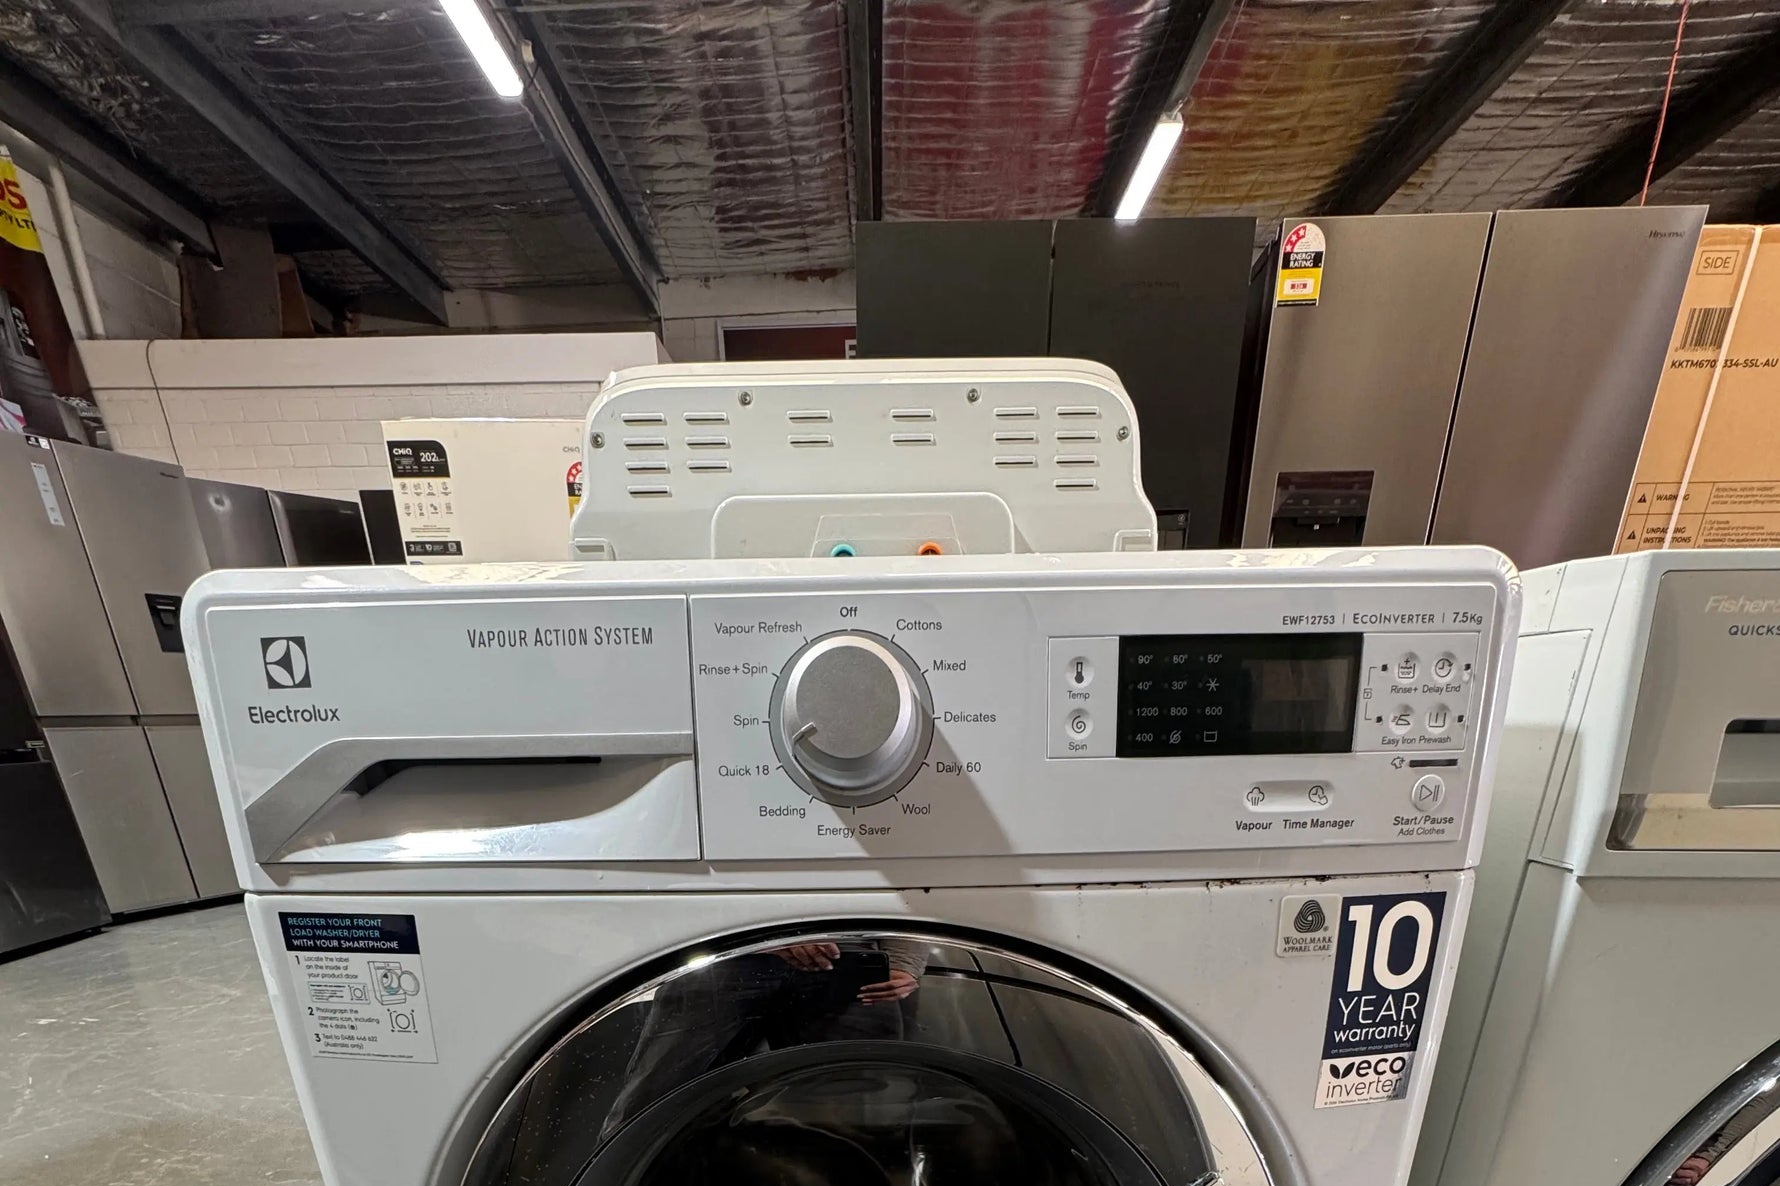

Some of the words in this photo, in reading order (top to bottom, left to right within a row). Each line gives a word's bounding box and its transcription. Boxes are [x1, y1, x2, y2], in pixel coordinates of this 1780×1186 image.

[1290, 252, 1315, 261] ENERGY
[1289, 260, 1314, 268] RATING
[1702, 256, 1732, 269] SIDE
[1670, 358, 1779, 369] KKTM670334-SSL-AU
[1656, 493, 1690, 501] WARNG
[1645, 526, 1687, 534] UNPACING
[1642, 536, 1692, 544] INSTRTIONS
[839, 607, 858, 618] Off
[1282, 615, 1336, 626] EWF12753
[1452, 611, 1483, 625] 7.5Kg
[714, 624, 755, 636] Vapour
[758, 621, 802, 634] Refresh
[896, 619, 943, 631] Cottons
[467, 628, 528, 649] VAPOUR
[534, 627, 588, 647] ACTION
[593, 626, 654, 646] SYSTEM
[933, 660, 966, 671] Mixed
[1422, 684, 1444, 695] Delay
[1445, 684, 1461, 692] End
[1067, 690, 1090, 701] Temp
[247, 705, 341, 725] Electrolux
[1136, 706, 1159, 716] 1200
[1170, 706, 1188, 716] 800
[1205, 706, 1223, 716] 600
[733, 715, 760, 728] Spin
[944, 711, 996, 723] Delicates
[1135, 733, 1154, 742] 400
[1381, 736, 1400, 747] Easy
[1401, 736, 1416, 745] Iron
[1418, 735, 1451, 745] Prewash
[1068, 742, 1088, 752] Spin
[718, 765, 751, 777] Quick
[755, 765, 770, 776] 18
[936, 762, 963, 775] Daily
[966, 762, 982, 773] 60
[759, 806, 806, 819] Bedding
[902, 803, 931, 815] Wool
[1235, 820, 1273, 832] Vapour
[1282, 819, 1307, 829] Time
[1310, 818, 1355, 830] Manager
[1393, 815, 1454, 827] Start/Pause
[817, 825, 856, 838] Energy
[859, 824, 891, 836] Saver
[1398, 828, 1415, 836] Add
[1416, 827, 1445, 836] Clothes
[287, 917, 326, 926] REGISTER
[327, 918, 351, 927] YOUR
[353, 919, 382, 927] FRONT
[289, 928, 313, 937] LOAD
[314, 929, 381, 938] WASHER/DRYER
[291, 939, 314, 947] WITH
[315, 940, 340, 948] YOUR
[341, 940, 400, 949] SMARTPHONE
[1283, 936, 1333, 945] WOOLMARK
[1282, 945, 1311, 953] APPAREL
[1312, 944, 1330, 952] CARE
[1346, 900, 1434, 993] 10
[294, 955, 300, 965] 1
[307, 1006, 315, 1016] 2
[1338, 992, 1420, 1026] YEAR
[314, 1033, 321, 1042] 3
[1333, 1022, 1416, 1044] warranty
[1355, 1056, 1406, 1077] eco
[1326, 1076, 1403, 1099] inverter
